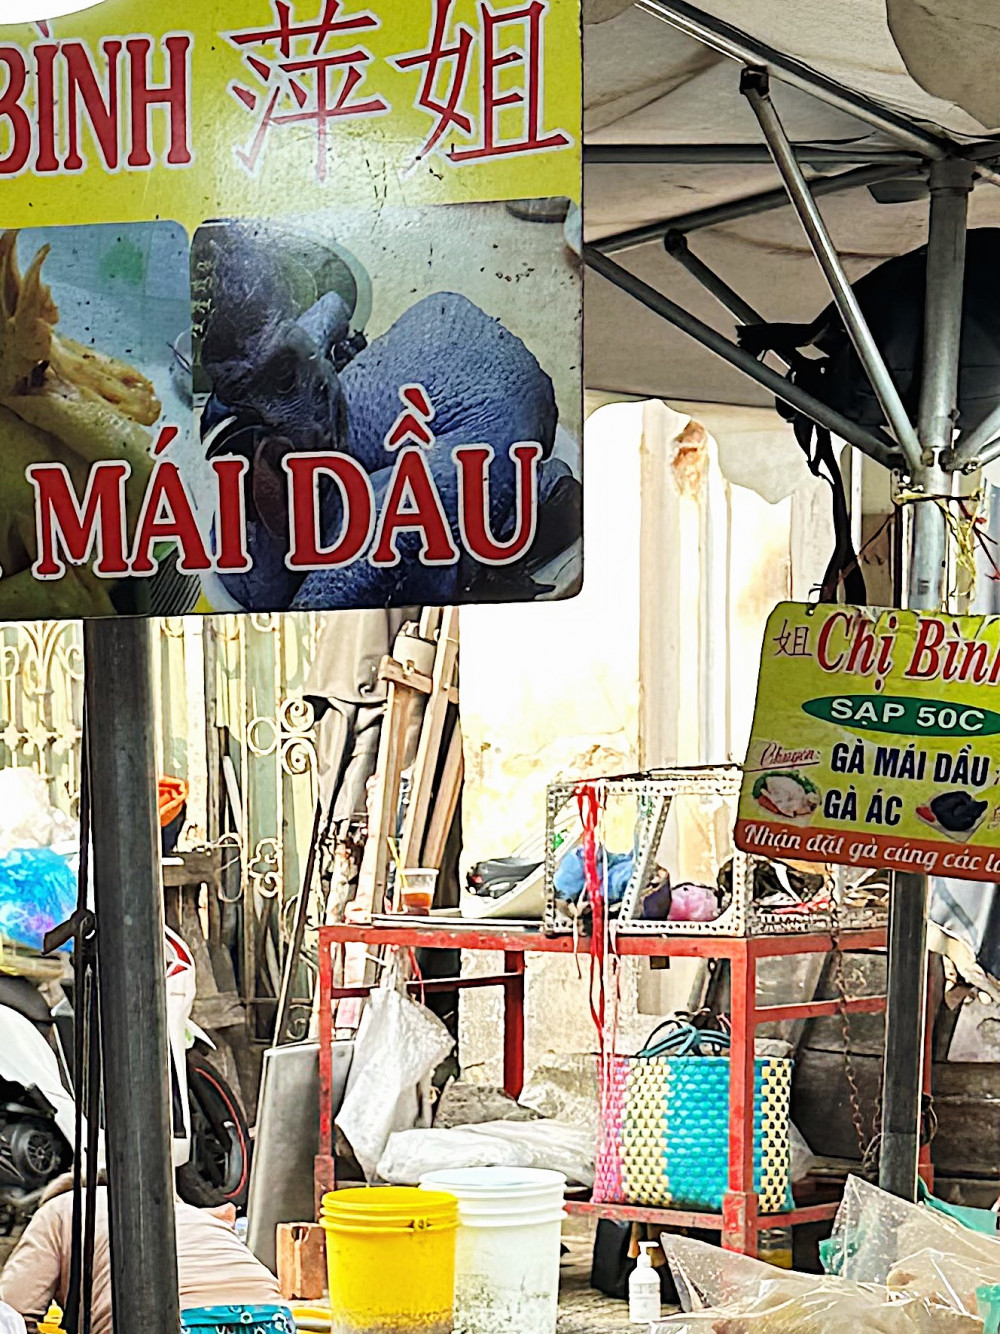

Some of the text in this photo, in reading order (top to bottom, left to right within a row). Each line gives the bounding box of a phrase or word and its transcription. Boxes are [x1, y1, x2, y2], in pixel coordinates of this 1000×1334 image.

[30, 426, 249, 577] MÁI
[286, 388, 542, 568] DẦU
[773, 619, 812, 657] 姐
[817, 611, 897, 691] Chị
[830, 698, 985, 731] SẠP 50C
[831, 738, 865, 774] GÀ
[873, 743, 927, 781] MÁI
[933, 744, 990, 787] DẦU
[823, 785, 903, 826] GÀ ÁC
[744, 823, 800, 852] Nhận
[850, 837, 878, 863] gà
[883, 842, 938, 872] cúng
[943, 849, 982, 871] các
